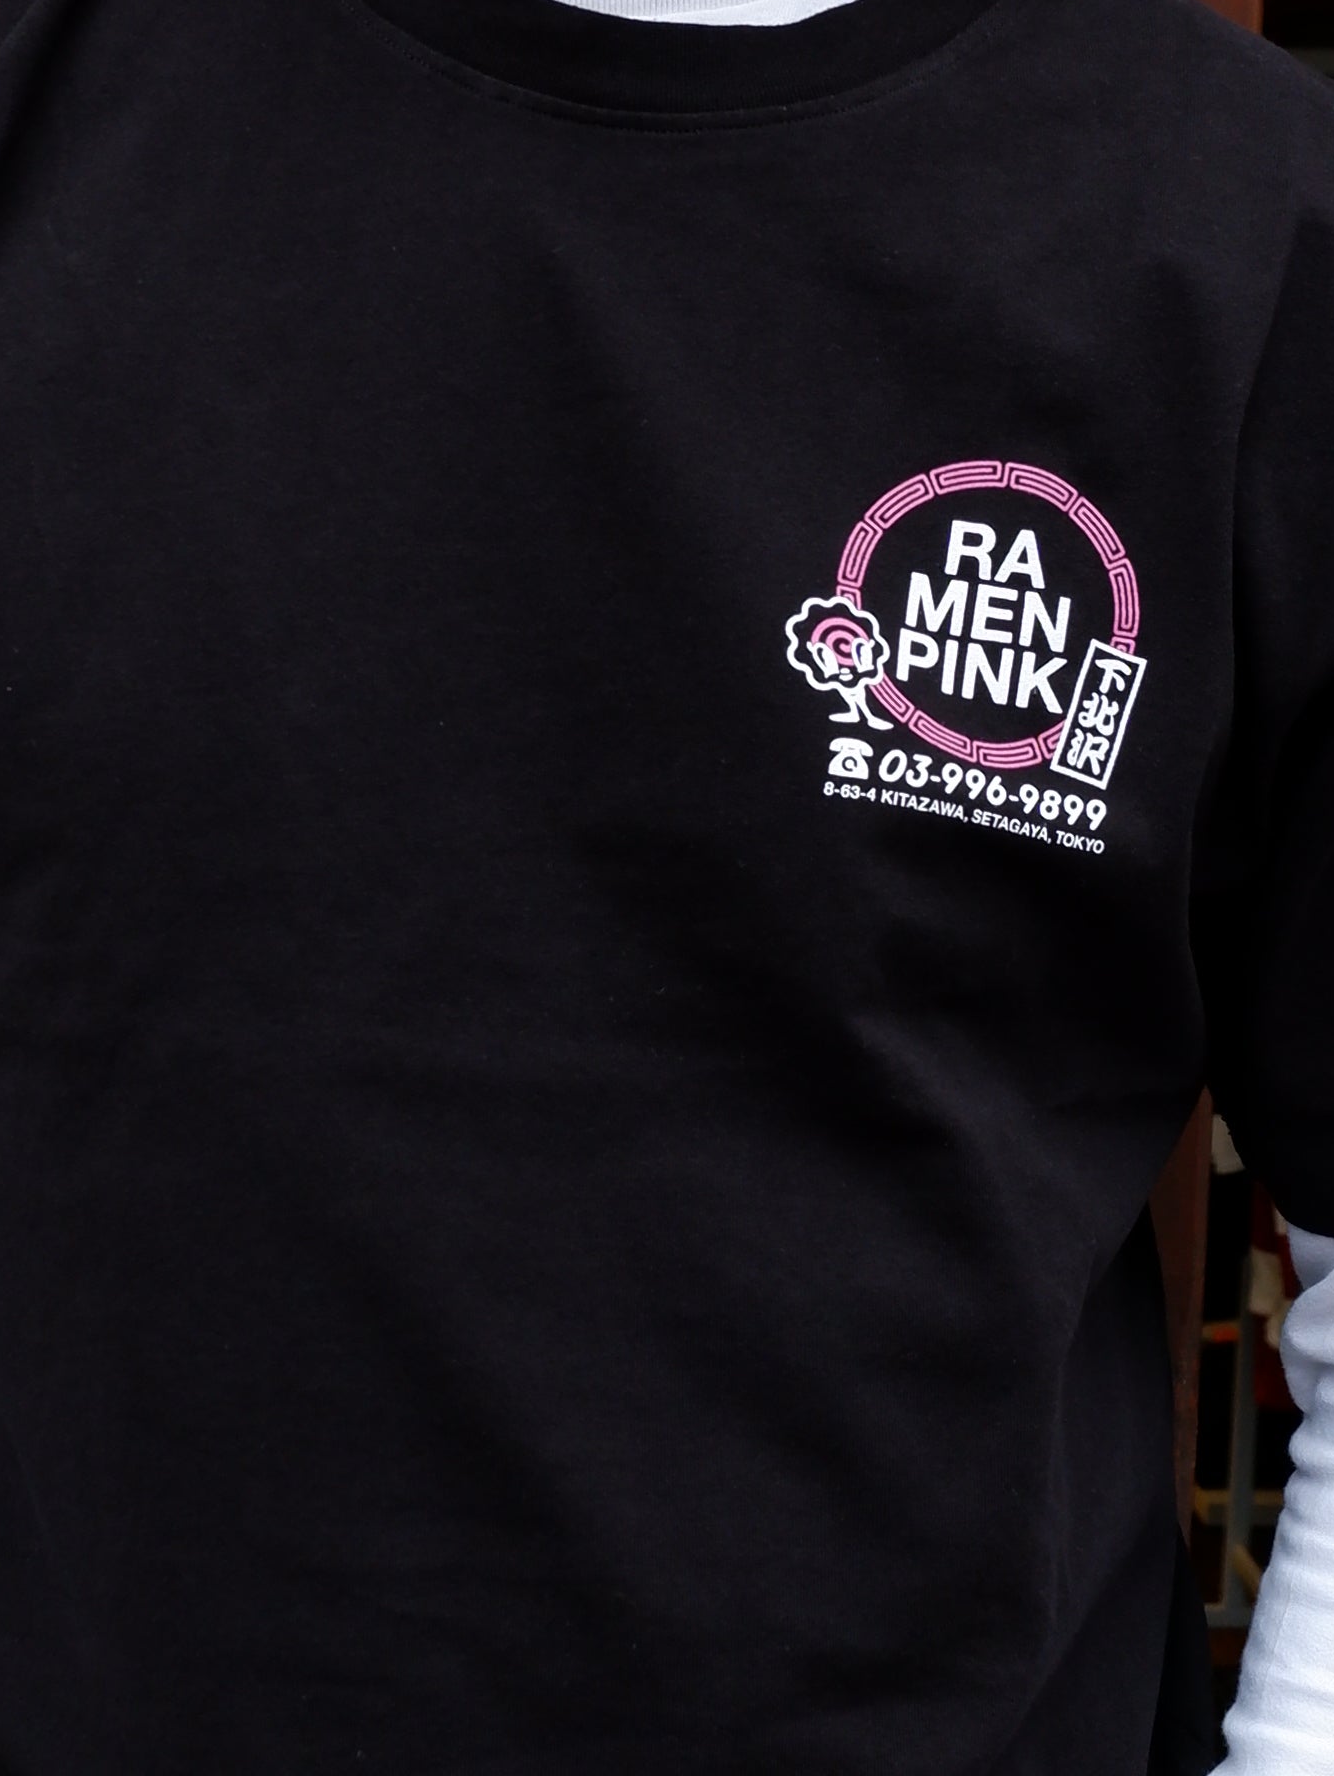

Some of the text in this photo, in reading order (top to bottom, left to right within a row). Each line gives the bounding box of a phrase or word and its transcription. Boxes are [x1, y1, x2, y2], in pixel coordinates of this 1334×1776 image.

[944, 519, 1046, 589] RA
[904, 571, 1071, 653] MEN
[895, 628, 1067, 714] PINK
[1066, 657, 1132, 775] 下北沢
[823, 781, 1105, 855] 8-63-4 KITAZAWA, SETAGAYA, TOKYO
[878, 749, 1107, 831] 03-996-9899
